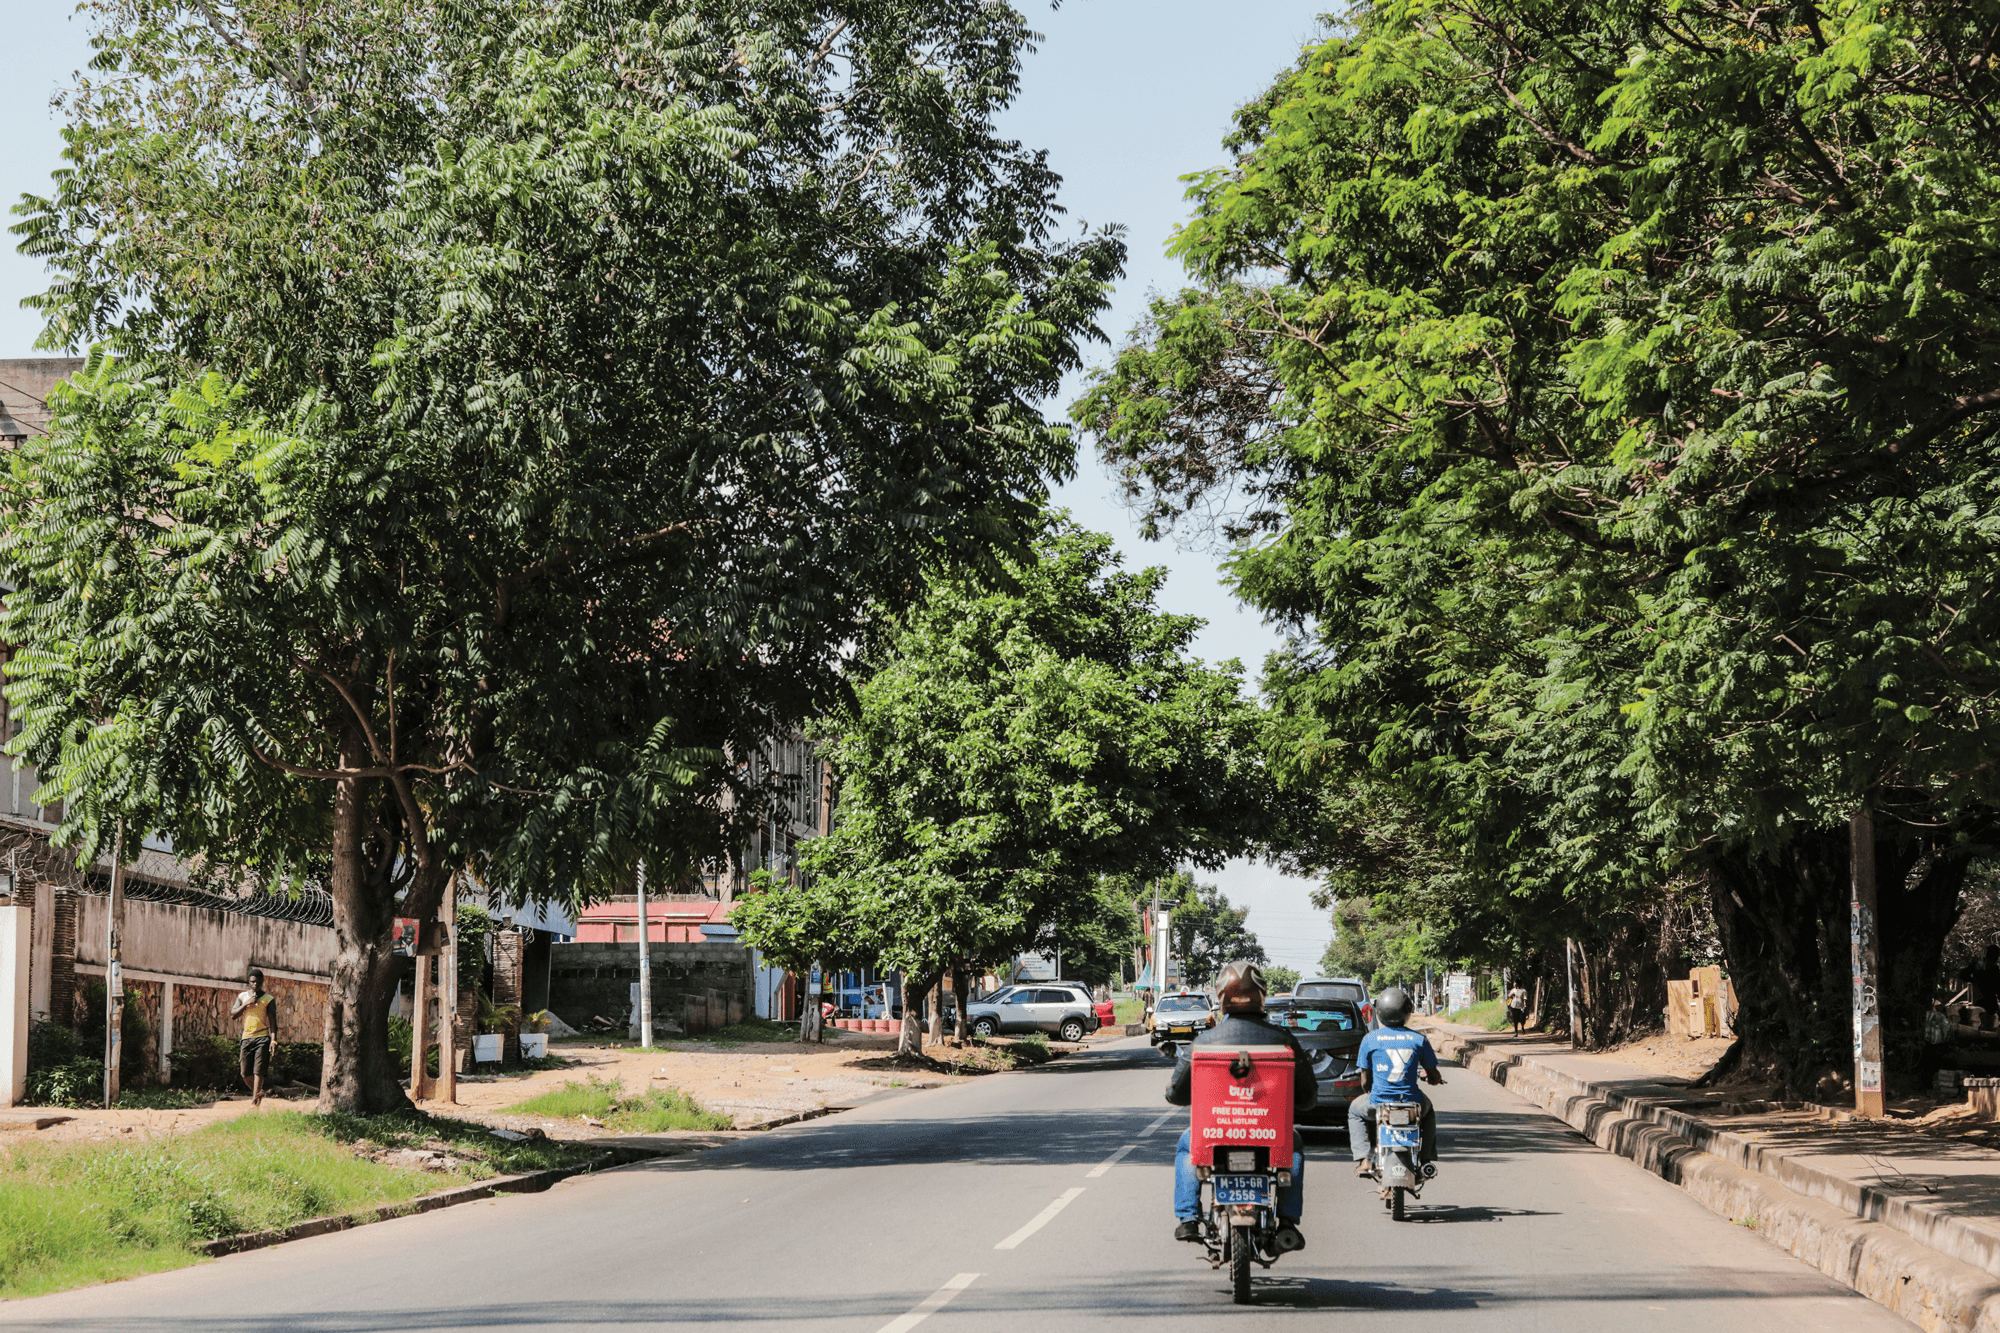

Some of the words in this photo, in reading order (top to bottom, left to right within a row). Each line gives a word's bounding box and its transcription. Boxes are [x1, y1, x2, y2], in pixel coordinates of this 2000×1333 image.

[1376, 1063, 1389, 1071] the
[1212, 1107, 1231, 1115] FREE
[1232, 1108, 1269, 1116] DELIVERY
[1203, 1128, 1224, 1138] 028
[1225, 1128, 1247, 1139] 400
[1249, 1129, 1277, 1139] 3000
[1220, 1177, 1263, 1188] M-15-GR
[1229, 1190, 1256, 1201] 2556
